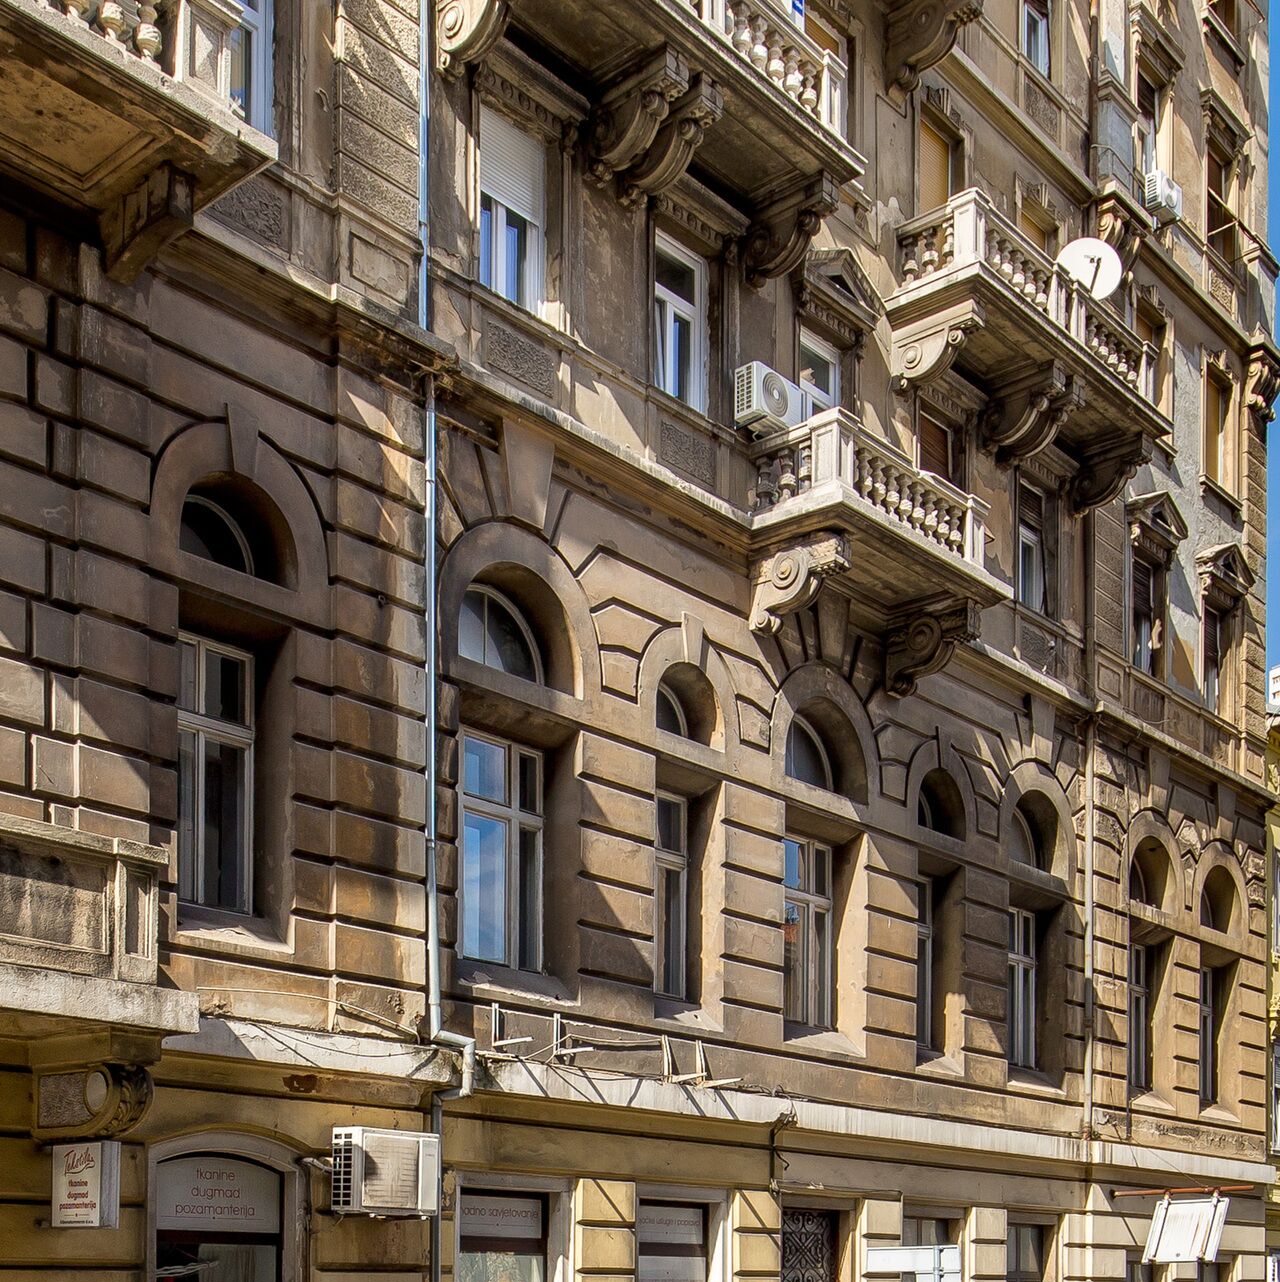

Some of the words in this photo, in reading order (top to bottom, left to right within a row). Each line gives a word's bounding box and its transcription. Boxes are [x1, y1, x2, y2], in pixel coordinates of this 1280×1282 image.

[196, 1168, 236, 1181] tkanine
[68, 1179, 89, 1188] tkanine
[67, 1191, 89, 1201] dugmad
[191, 1186, 241, 1200] dugmad
[59, 1201, 97, 1212] pozamanterija
[175, 1204, 256, 1218] pozamanterija
